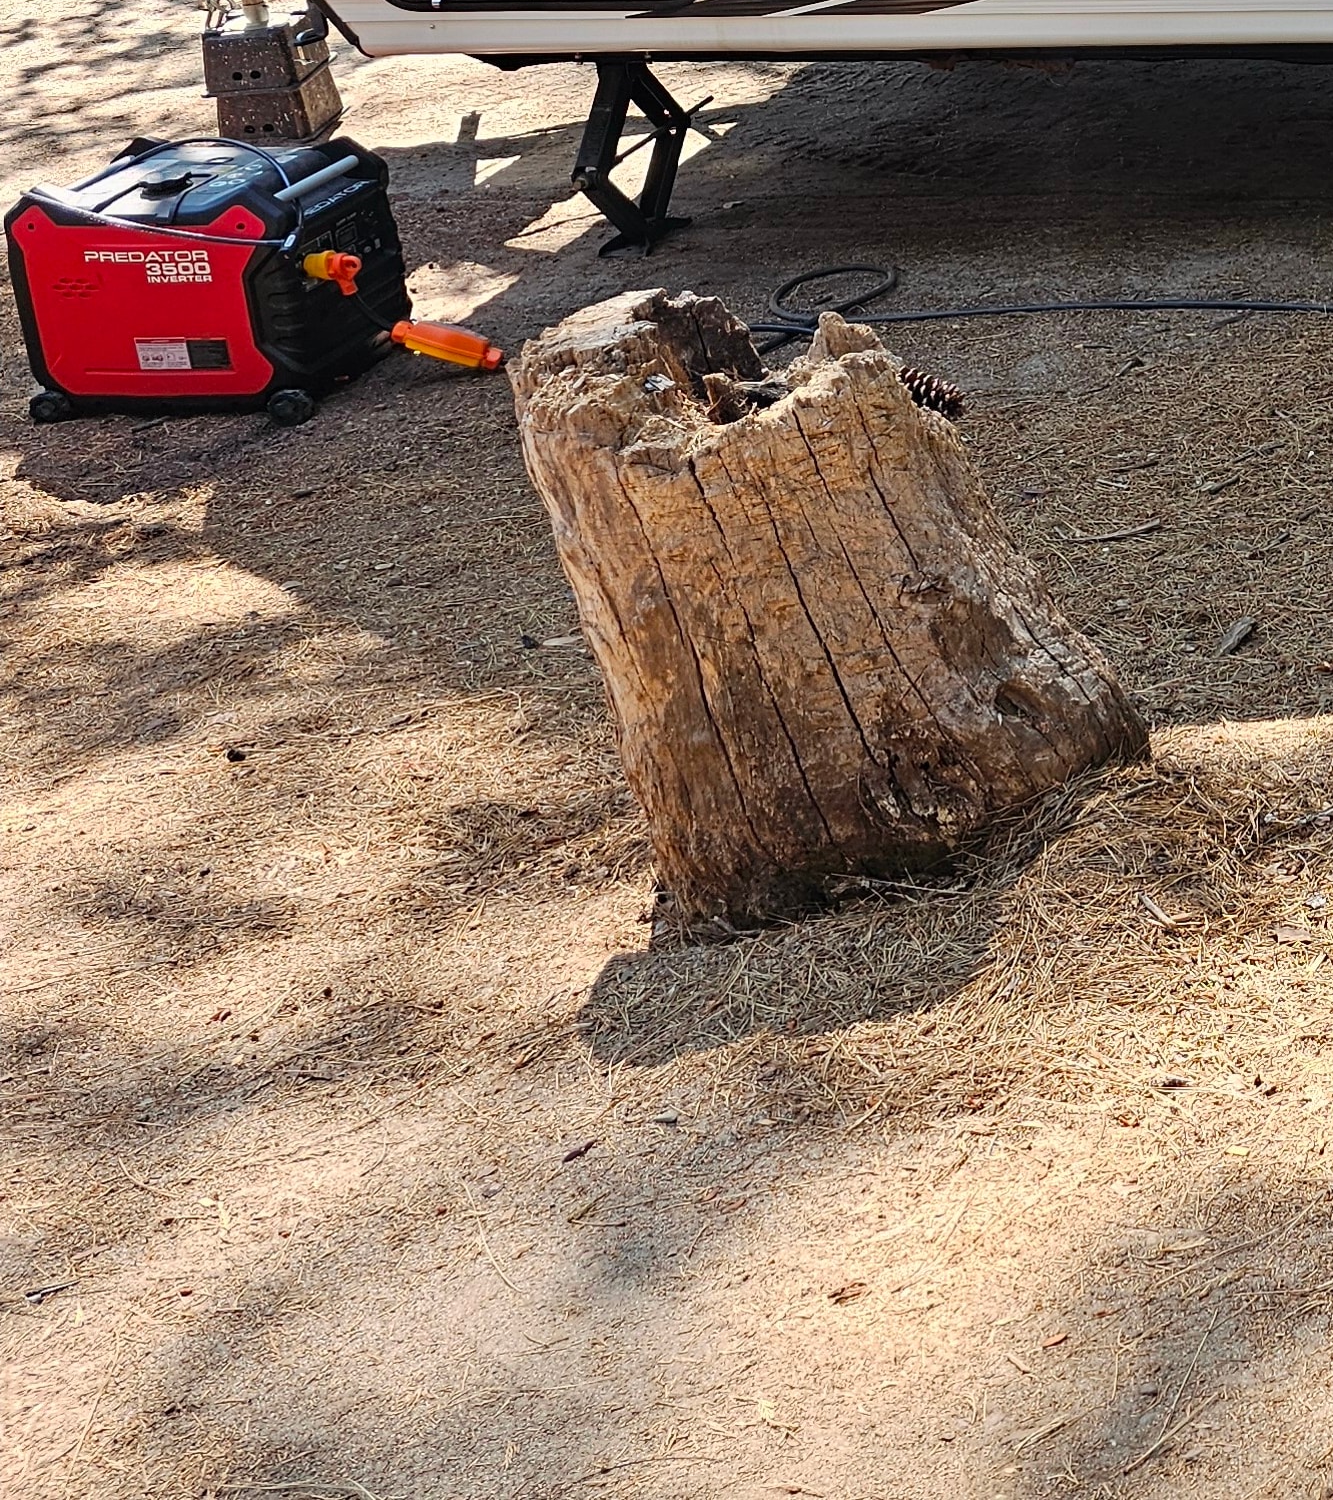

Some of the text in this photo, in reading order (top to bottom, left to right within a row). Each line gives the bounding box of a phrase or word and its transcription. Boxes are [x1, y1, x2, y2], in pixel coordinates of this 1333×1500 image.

[83, 250, 209, 263] PREDATOR
[145, 261, 211, 276] 3500
[147, 274, 213, 284] INVERTER
